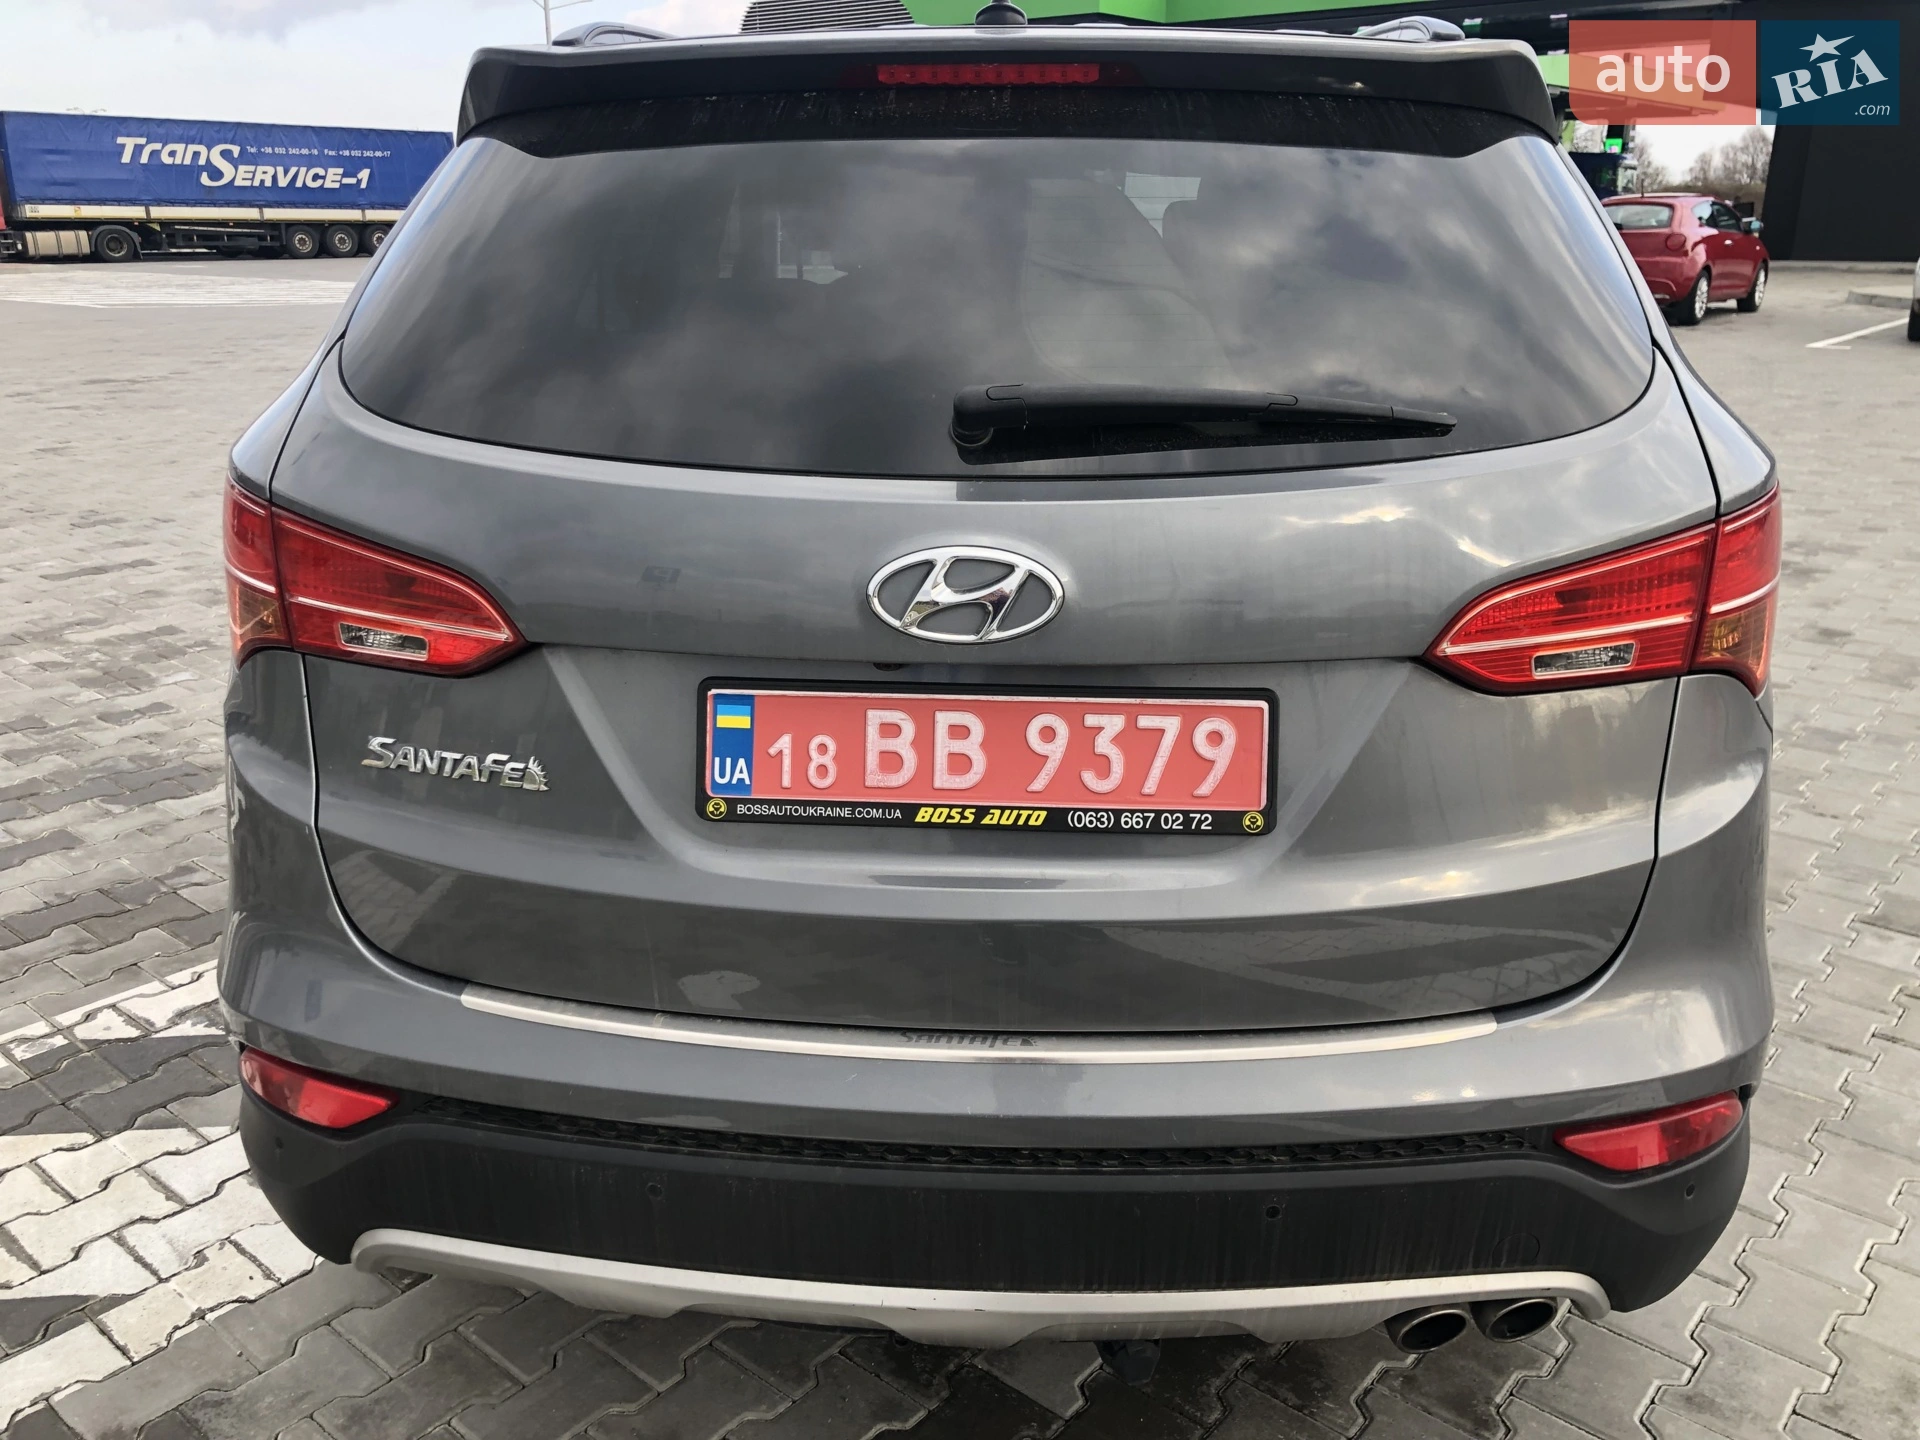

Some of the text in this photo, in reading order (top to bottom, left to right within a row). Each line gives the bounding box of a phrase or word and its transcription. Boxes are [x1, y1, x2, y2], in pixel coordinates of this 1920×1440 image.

[766, 708, 1238, 798] 18 BB 9379
[713, 756, 751, 786] UA
[736, 803, 1213, 831] BOSSAUTOUKRAINE.COM.UA BOSS AUTO (063) 667 02 72
